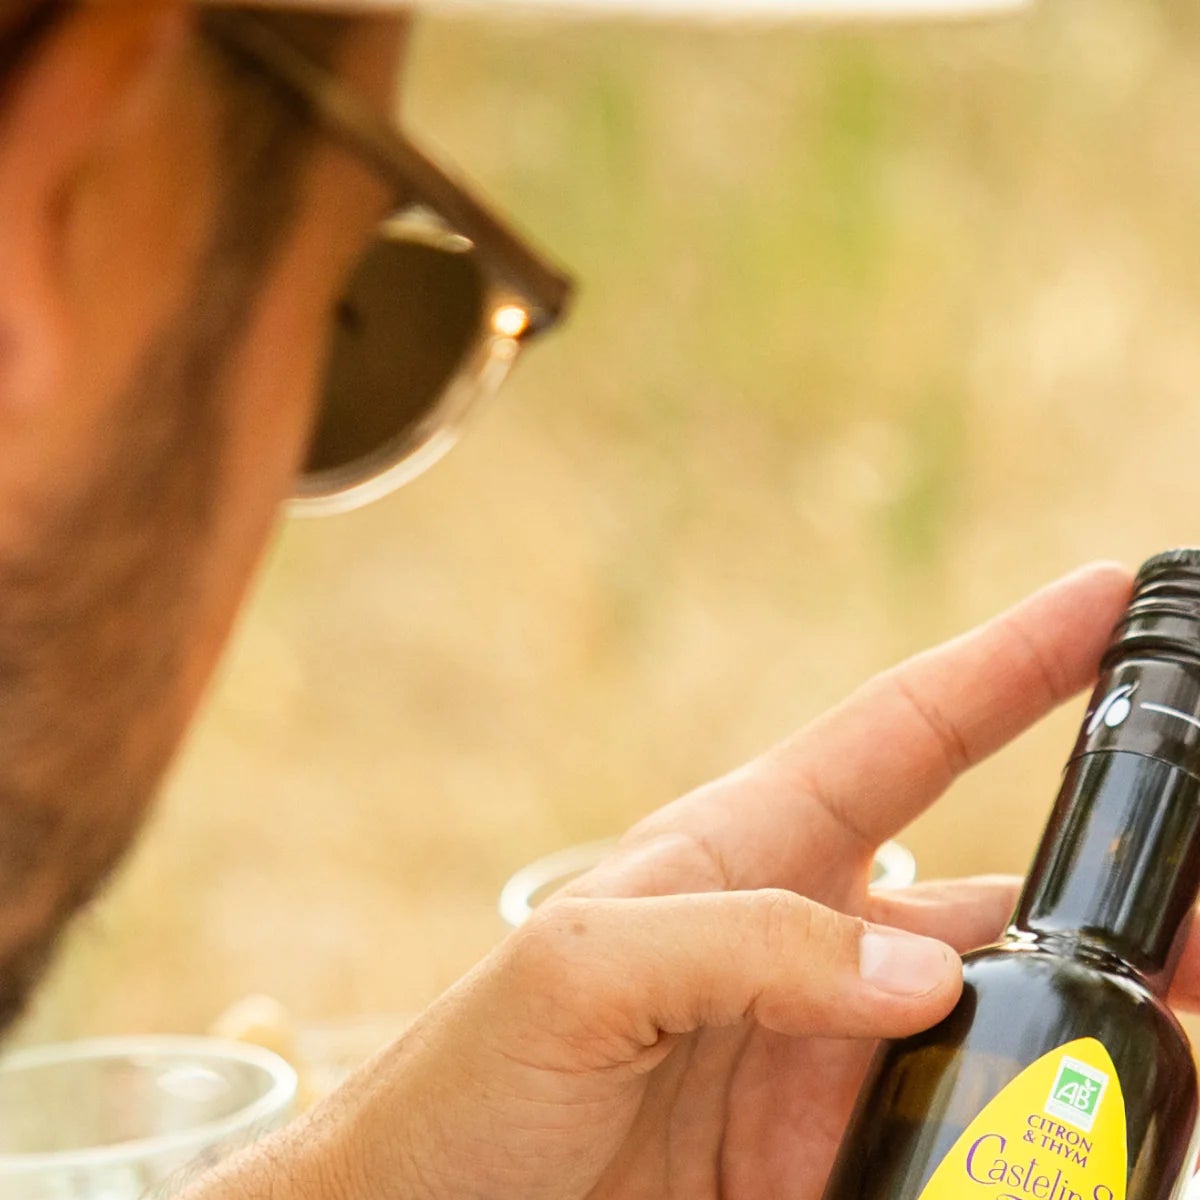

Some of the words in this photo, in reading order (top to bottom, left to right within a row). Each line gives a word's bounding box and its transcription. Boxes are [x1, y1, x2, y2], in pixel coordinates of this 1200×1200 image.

[1055, 1082, 1091, 1110] AB
[1022, 1129, 1035, 1143] &
[1041, 1134, 1087, 1168] THYM
[1027, 1114, 1093, 1152] CITRON
